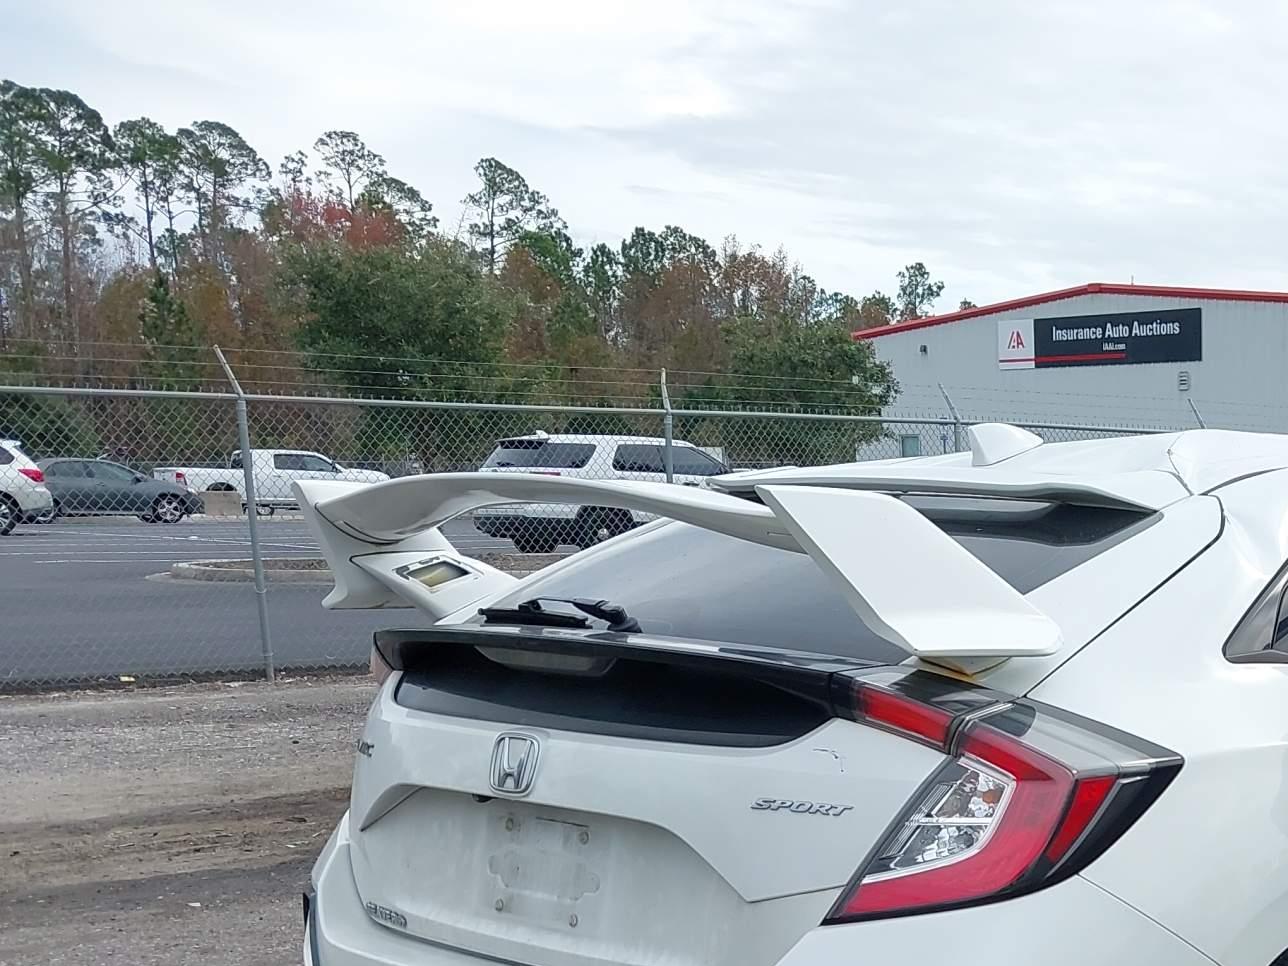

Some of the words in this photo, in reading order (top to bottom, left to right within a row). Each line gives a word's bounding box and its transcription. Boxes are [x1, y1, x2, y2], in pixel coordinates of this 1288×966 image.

[1052, 325, 1102, 342] Insurance
[1105, 323, 1129, 339] Auto
[1132, 320, 1180, 337] Auctions
[750, 798, 855, 817] SPORT
